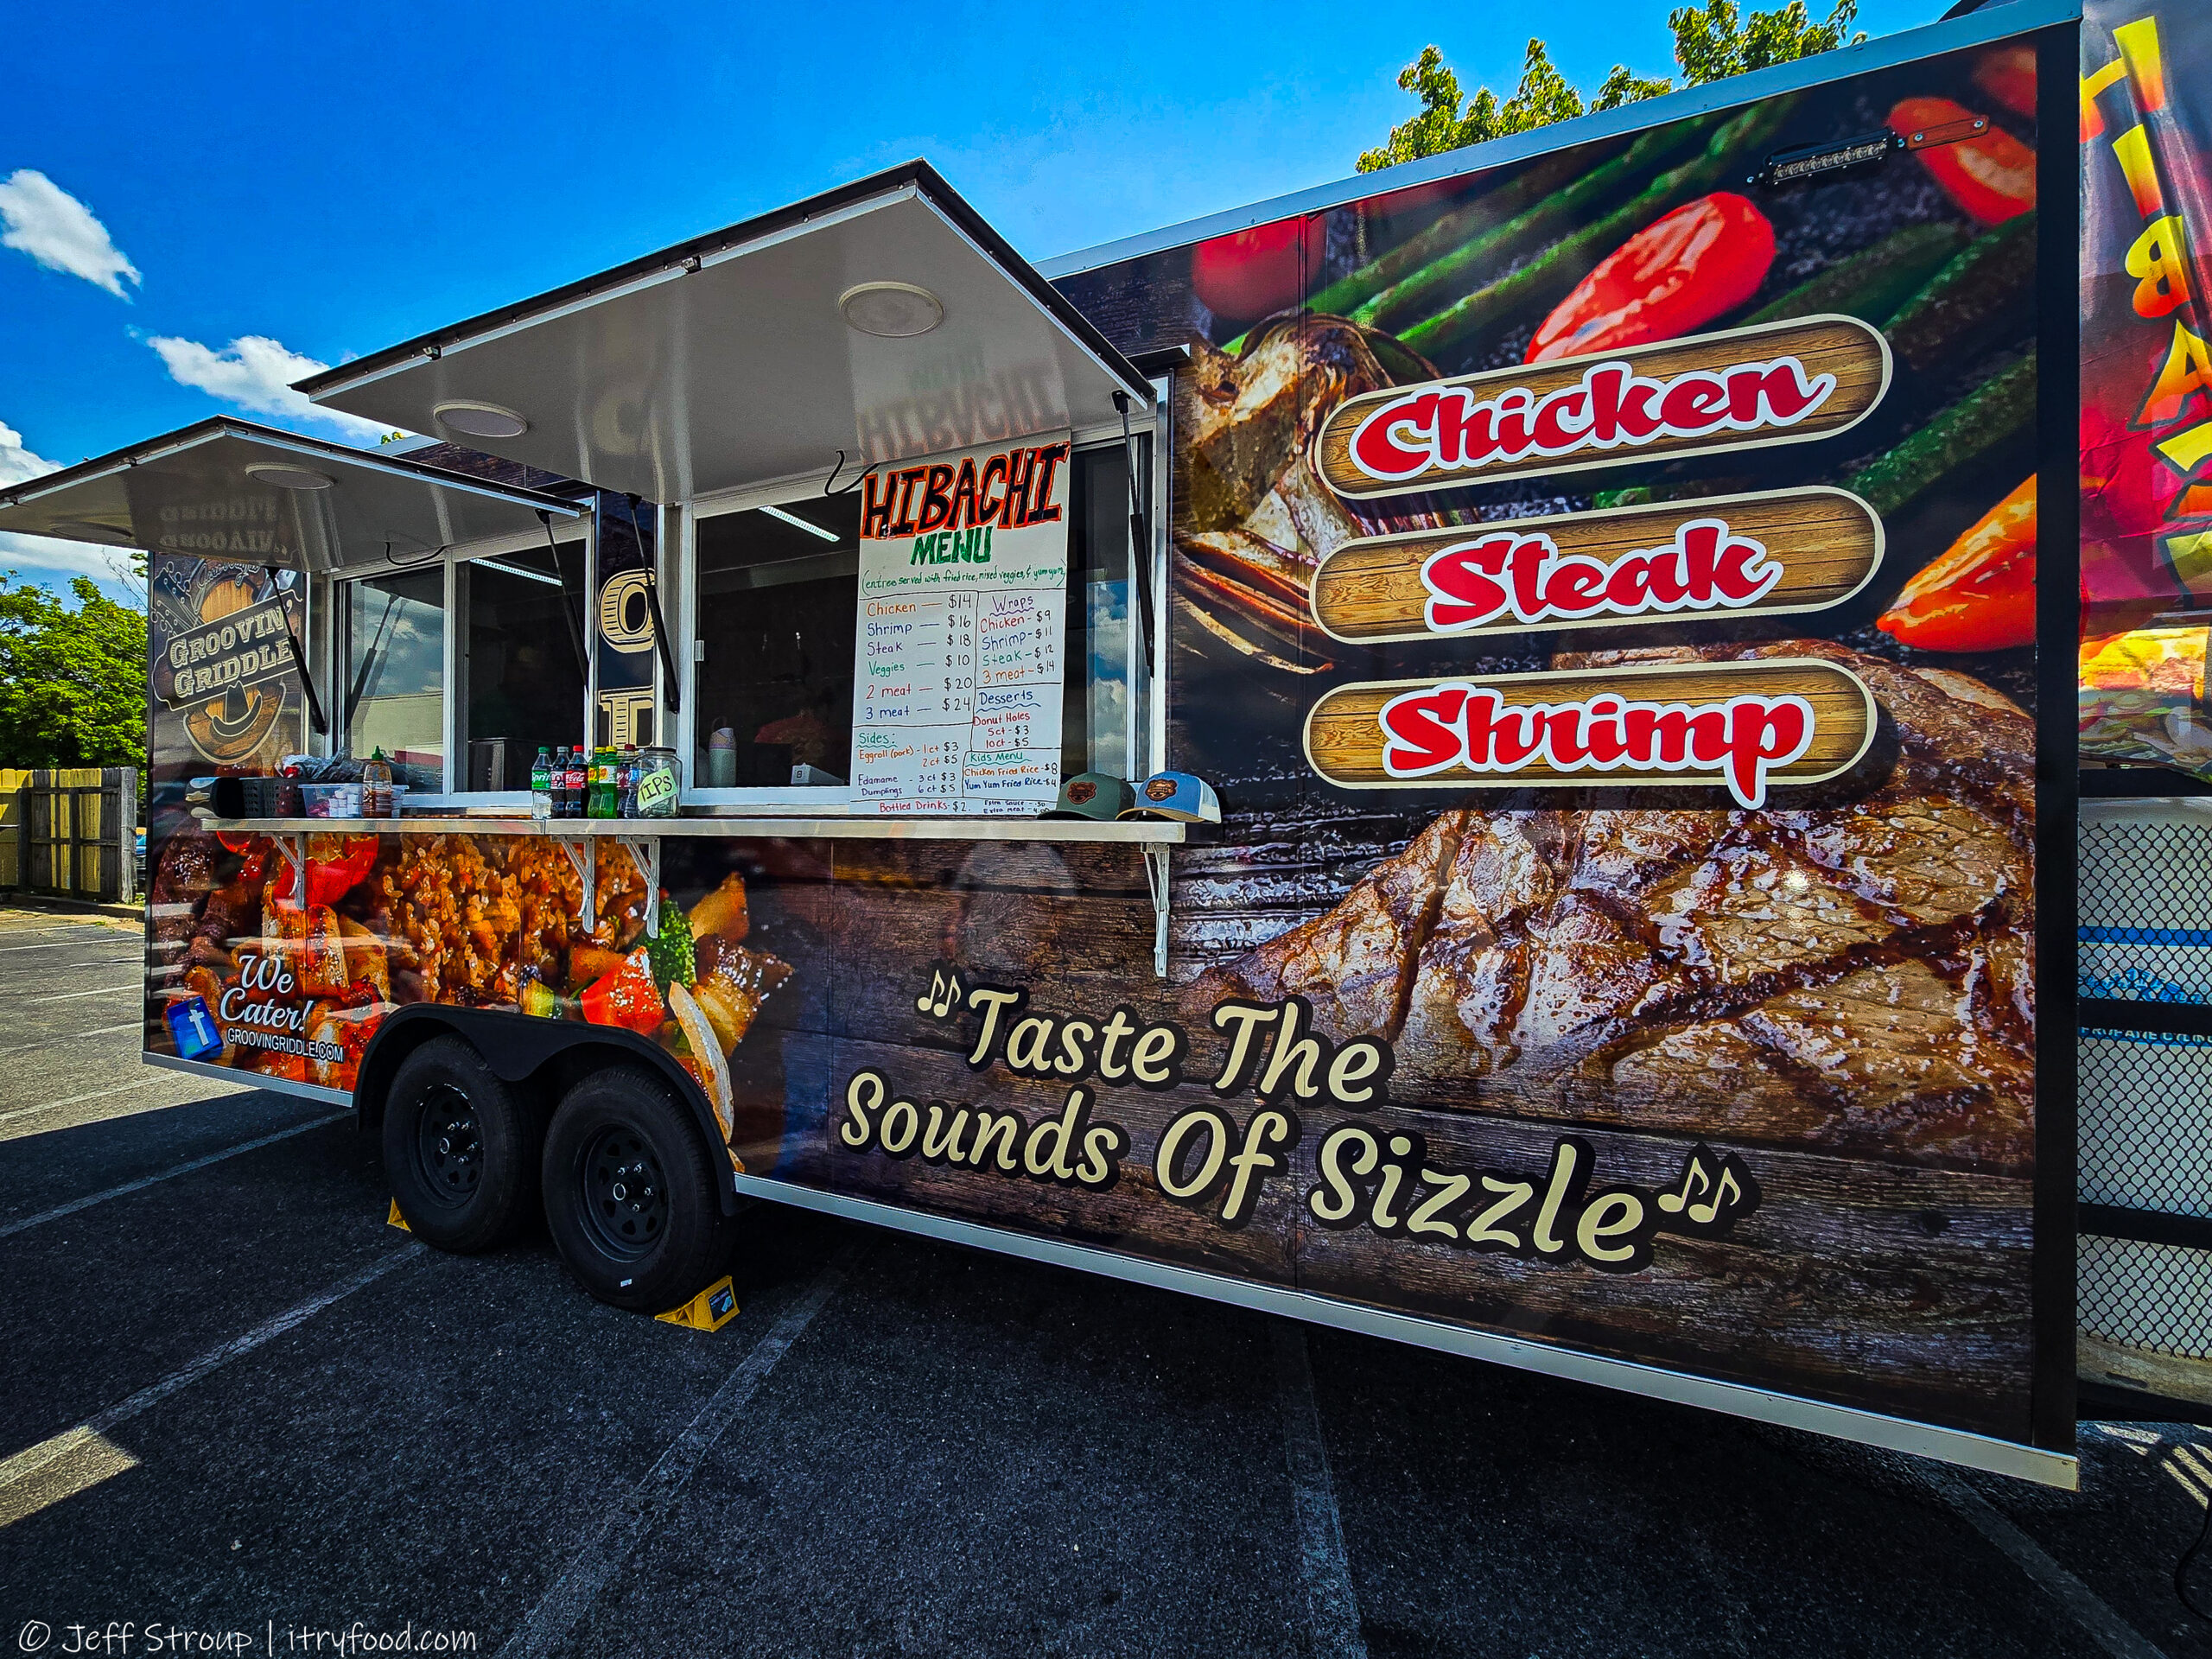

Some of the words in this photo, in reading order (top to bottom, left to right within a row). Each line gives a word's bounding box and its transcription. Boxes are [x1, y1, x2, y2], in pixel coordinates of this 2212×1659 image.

[1351, 359, 1834, 479] Chicken
[860, 441, 1071, 540] HIBACHI
[910, 525, 994, 566] MENU
[898, 572, 922, 585] served
[925, 573, 941, 583] with
[944, 569, 961, 582] fried
[978, 564, 998, 580] mixed
[1421, 520, 1782, 631] Steak
[867, 601, 917, 617] Chicken
[948, 594, 971, 608] $14
[992, 594, 1033, 612] Wraps
[867, 622, 912, 637] Shrimp
[947, 614, 971, 629] $16
[980, 616, 1025, 633] Chicken
[1036, 610, 1051, 623] $9
[169, 599, 293, 669] GROOVIN'
[867, 641, 903, 657] Steak
[946, 633, 971, 647] $18
[982, 632, 1026, 652] Shrimp
[1035, 626, 1052, 639] $11
[868, 660, 906, 677] Veggies
[944, 654, 970, 668] $10
[982, 650, 1022, 667] Steak
[1034, 644, 1053, 659] $12
[173, 640, 296, 698] GRIDDLE
[982, 670, 992, 684] 3
[995, 665, 1026, 683] meat
[1037, 659, 1054, 675] $14
[866, 684, 874, 700] 2
[881, 683, 912, 697] meat
[944, 677, 973, 691] $20
[978, 690, 1033, 706] Desserts
[866, 706, 874, 720] 3
[880, 705, 910, 718] meat
[942, 696, 970, 712] $24
[973, 713, 1002, 726] Donut
[1006, 711, 1031, 722] Holes
[859, 732, 895, 744] Sides:
[1014, 725, 1029, 735] $3
[859, 749, 888, 763] Eggroll
[890, 745, 914, 759] (pork)
[944, 741, 959, 752] $3
[1014, 737, 1029, 747] $5
[1381, 684, 1812, 808] Shrimp
[944, 754, 958, 765] $5
[970, 753, 992, 762] Kids
[995, 752, 1023, 761] Menu
[858, 774, 899, 785] Edamame
[941, 772, 957, 781] $3
[963, 767, 995, 777] Chicken
[639, 774, 673, 804] TIPS
[861, 786, 903, 798] Dumplings
[940, 784, 956, 793] $5
[964, 779, 982, 790] Yum
[983, 779, 1001, 789] Yum
[880, 801, 911, 813] Bottled
[238, 954, 295, 995] We
[220, 987, 315, 1032] Cater!
[227, 1027, 345, 1063] GROOVINGRIDDLE.COM
[967, 988, 1175, 1085] Taste
[1213, 1001, 1382, 1104] The
[841, 1070, 1120, 1183] Sounds
[1156, 1107, 1288, 1223] Of
[1309, 1127, 1645, 1264] Sizzle
